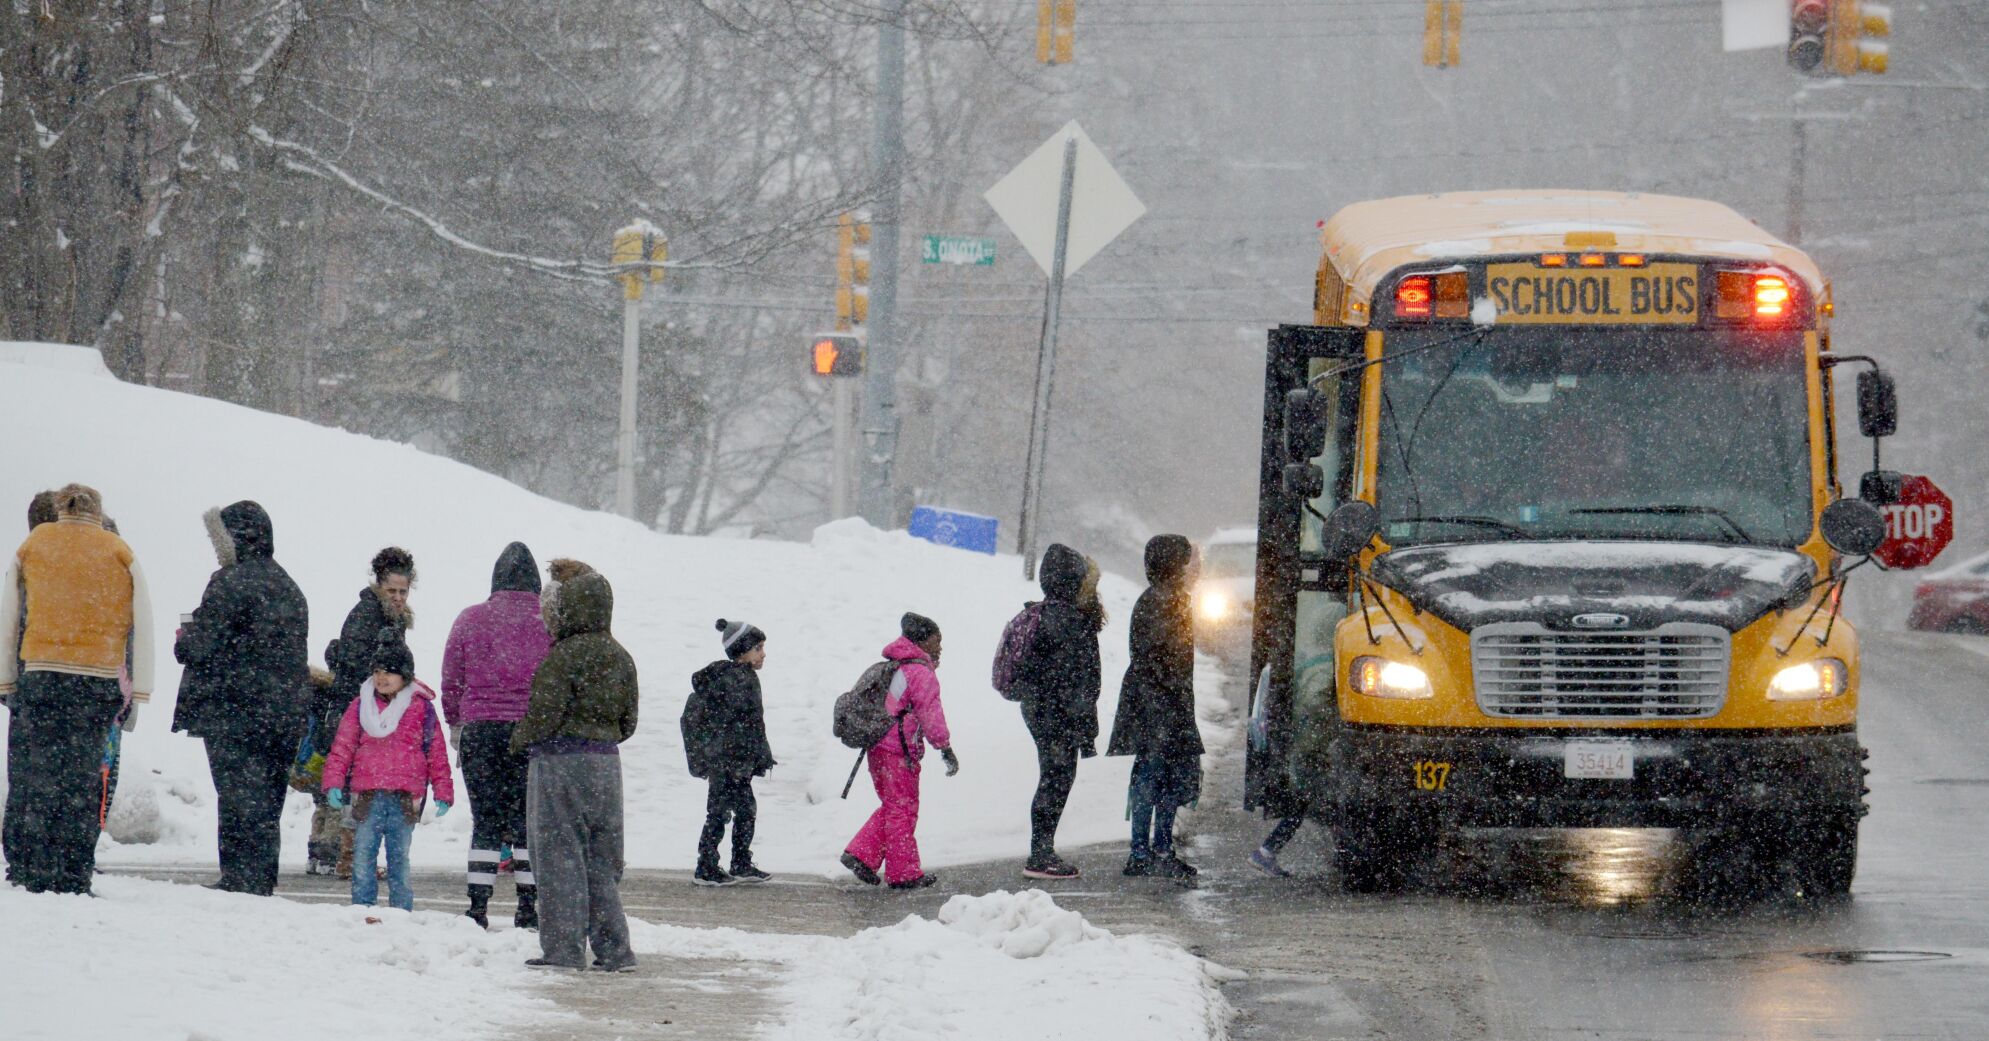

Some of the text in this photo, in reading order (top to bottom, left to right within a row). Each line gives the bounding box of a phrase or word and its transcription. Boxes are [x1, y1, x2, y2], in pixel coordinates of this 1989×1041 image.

[1490, 276, 1695, 315] SCHOOL BUS
[1412, 760, 1451, 791] 137
[1577, 752, 1625, 770] 35414
